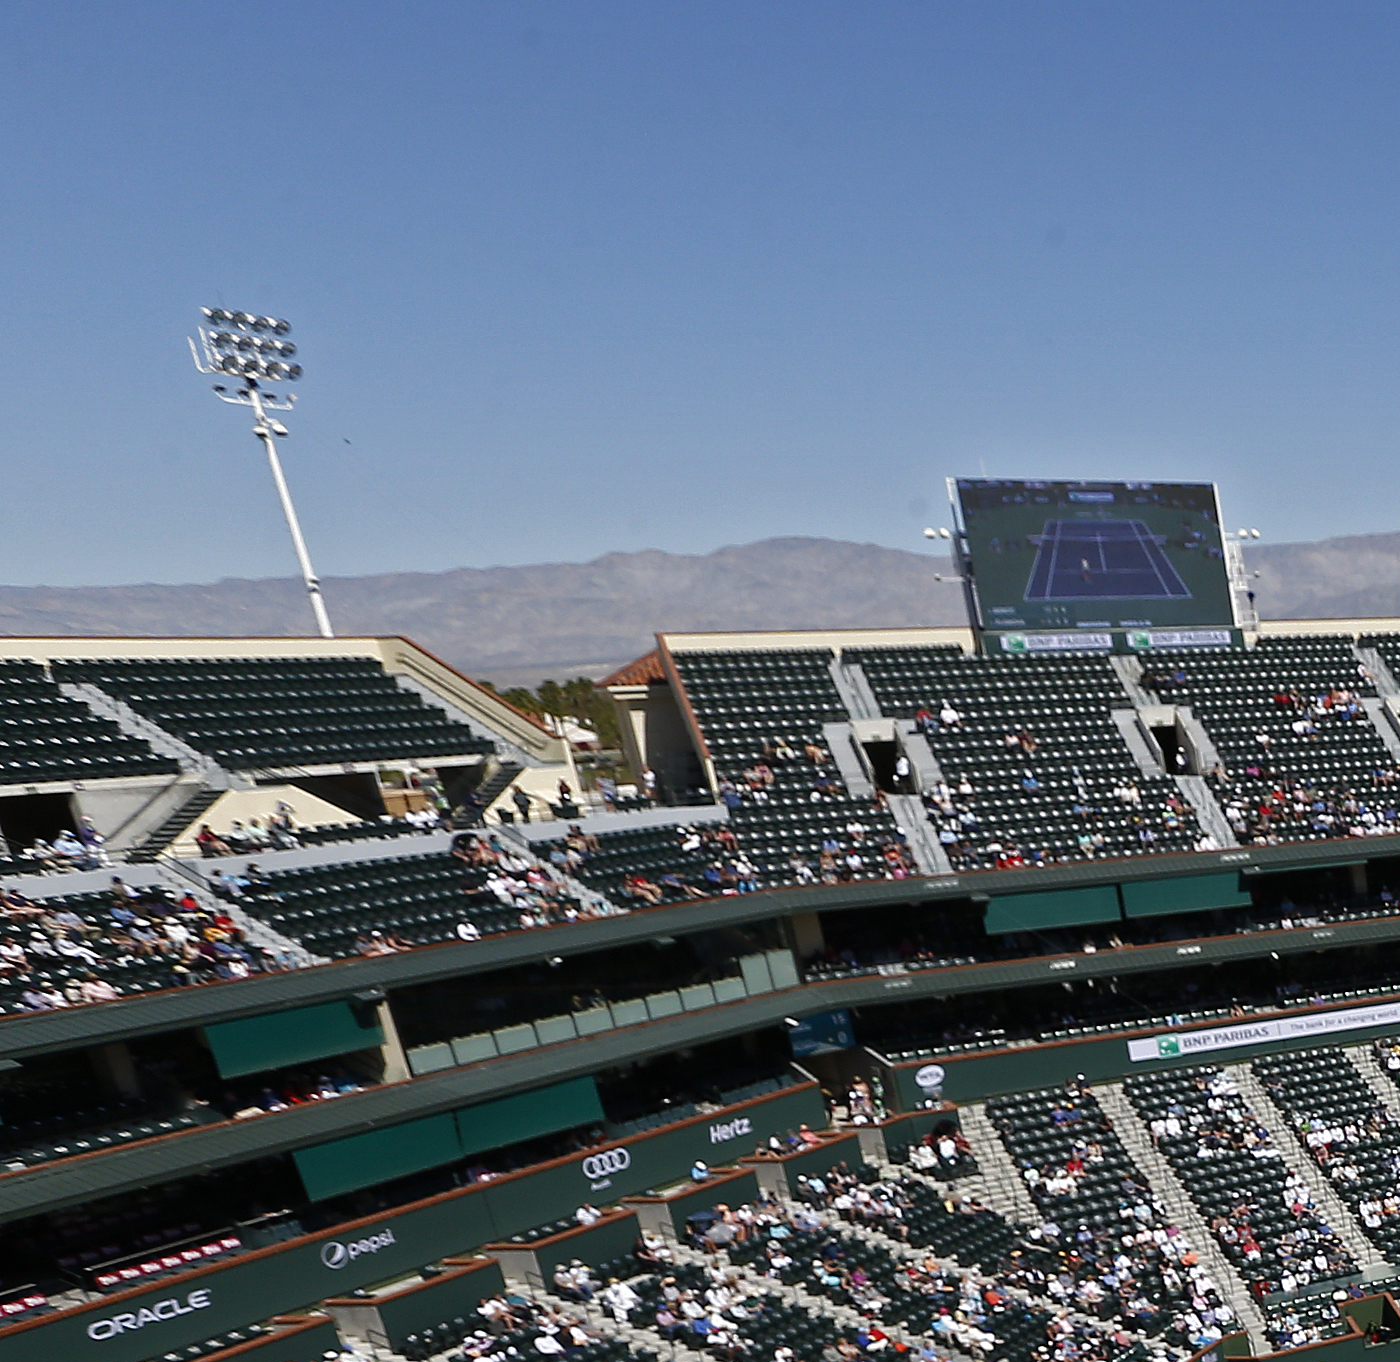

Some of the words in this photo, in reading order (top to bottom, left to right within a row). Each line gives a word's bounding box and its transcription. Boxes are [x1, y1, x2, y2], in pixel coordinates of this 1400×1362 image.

[1183, 1034, 1210, 1047] BNP
[1213, 1026, 1269, 1043] PARIBAS
[709, 1117, 753, 1144] Hertz
[347, 1228, 397, 1260] pepsi
[87, 1288, 212, 1340] ORACLE
